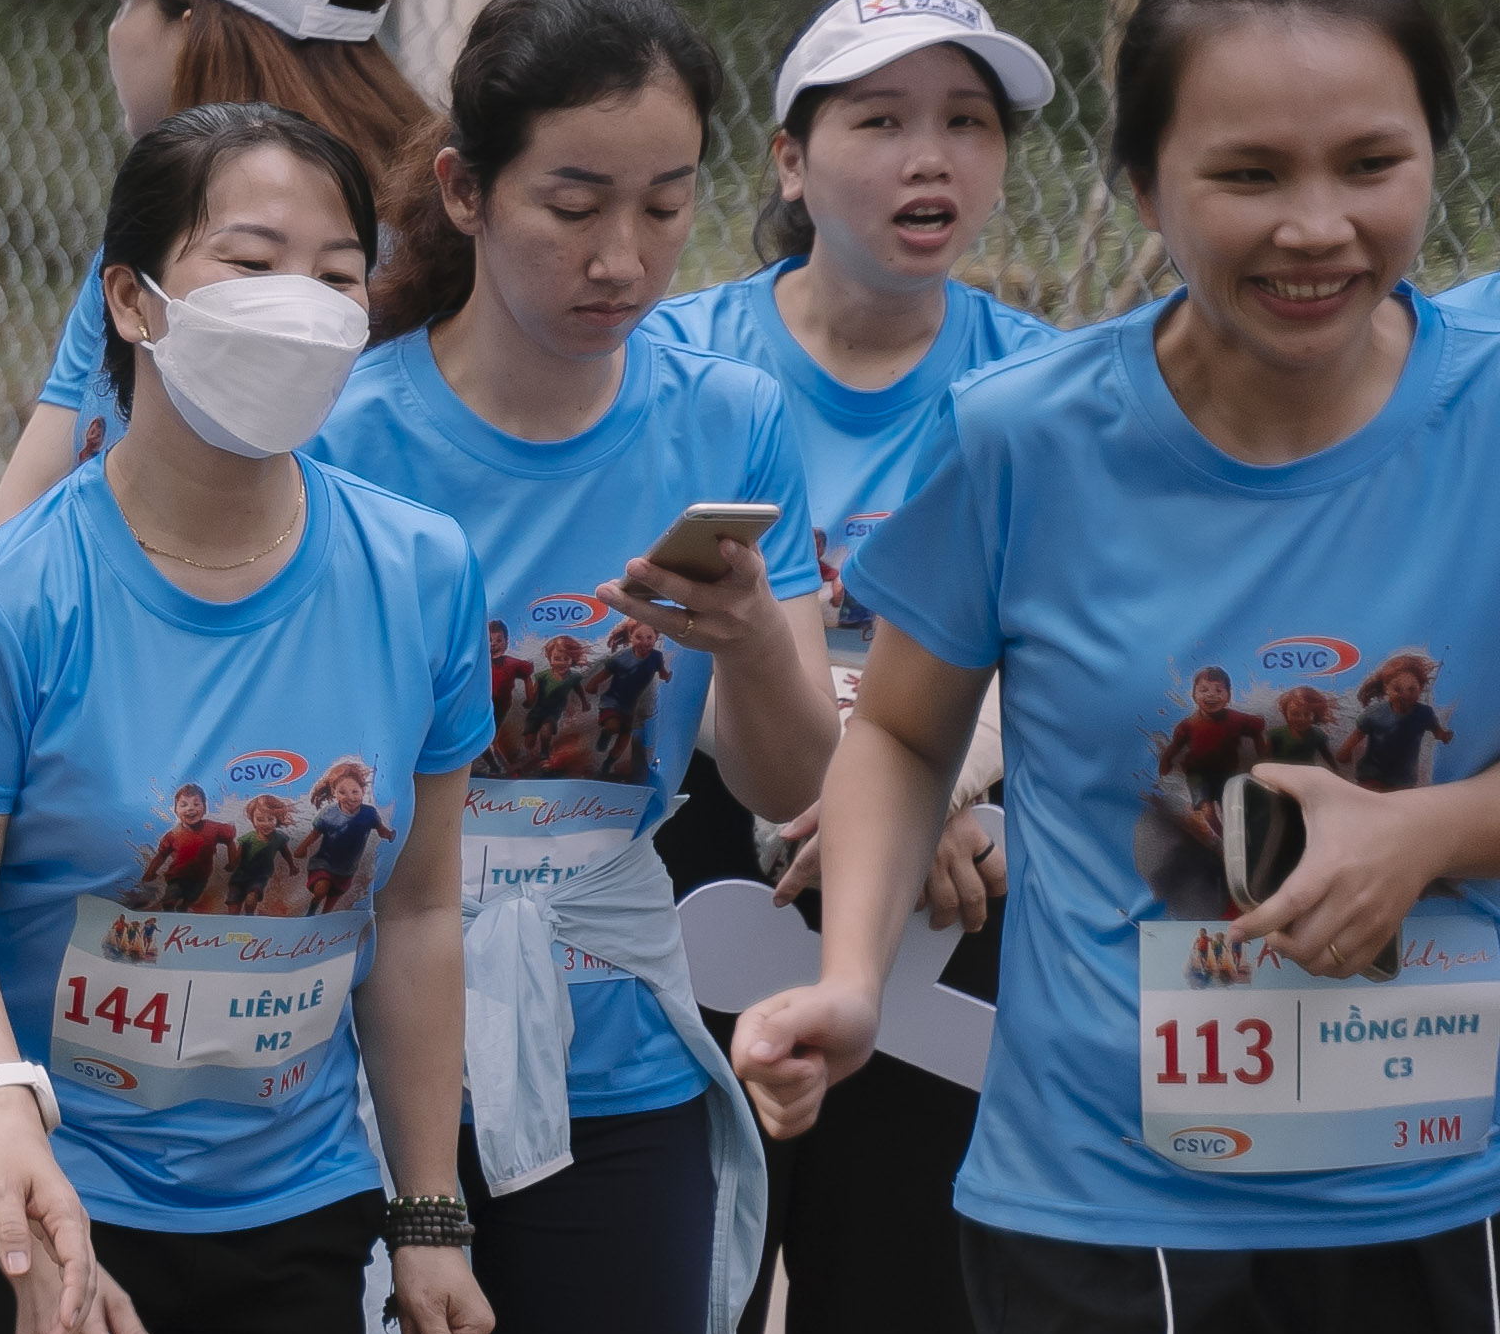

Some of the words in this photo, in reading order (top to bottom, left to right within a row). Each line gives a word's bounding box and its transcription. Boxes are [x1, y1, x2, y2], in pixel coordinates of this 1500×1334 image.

[532, 603, 584, 624] CSVC
[1262, 651, 1329, 670] CSVC
[229, 762, 284, 784] CSVC
[464, 787, 523, 819] Run
[532, 795, 643, 826] Children
[491, 855, 564, 886] TUYẾT
[163, 923, 230, 955] Run
[239, 930, 359, 962] Children
[564, 947, 576, 972] 3
[63, 975, 172, 1044] 144
[228, 990, 292, 1019] LIÊN
[297, 978, 325, 1012] LÊ
[1318, 1005, 1408, 1044] HỒNG
[1413, 1013, 1480, 1039] ANH
[254, 1031, 293, 1053] M2
[1156, 1017, 1275, 1085] 113
[73, 1060, 118, 1086] CSVC
[257, 1076, 275, 1099] 3
[279, 1060, 307, 1095] KM
[1383, 1057, 1414, 1080] C3
[1172, 1137, 1227, 1154] CSVC
[1392, 1120, 1408, 1149] 3
[1417, 1115, 1462, 1146] KM
